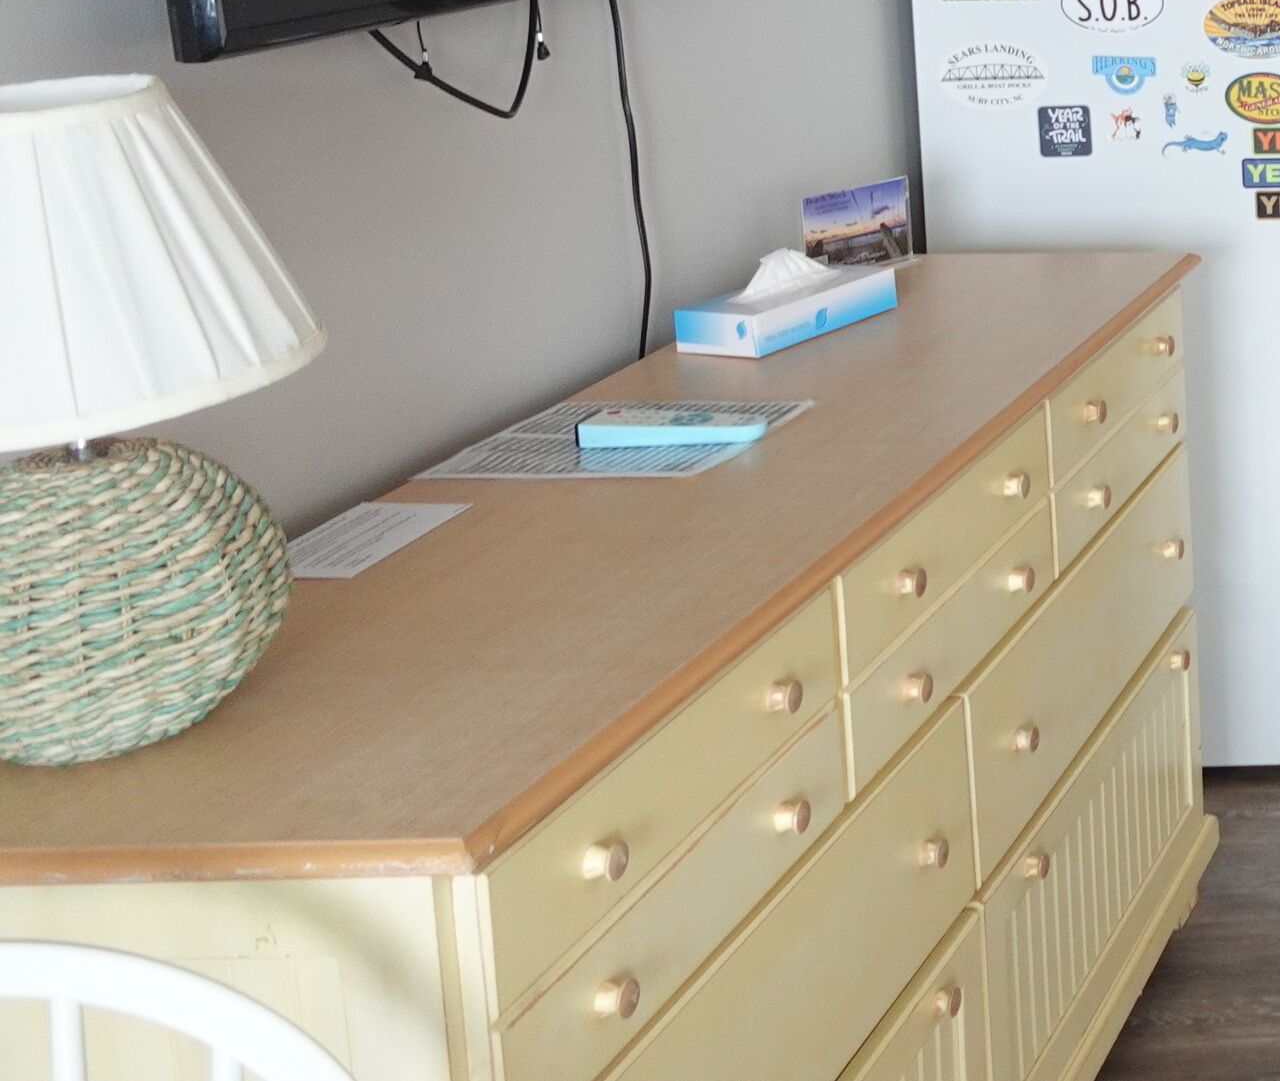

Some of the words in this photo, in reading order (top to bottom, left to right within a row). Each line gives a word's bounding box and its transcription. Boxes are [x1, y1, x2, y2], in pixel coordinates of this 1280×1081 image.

[1216, 37, 1249, 54] NORTH
[947, 44, 982, 67] SEARS
[984, 44, 1036, 65] LANDING
[1094, 56, 1156, 74] HERRING'S
[967, 94, 989, 105] SURF
[1013, 94, 1025, 102] NC
[1048, 107, 1084, 124] YEAR
[1053, 122, 1064, 130] OF
[1049, 128, 1087, 144] TRAIL
